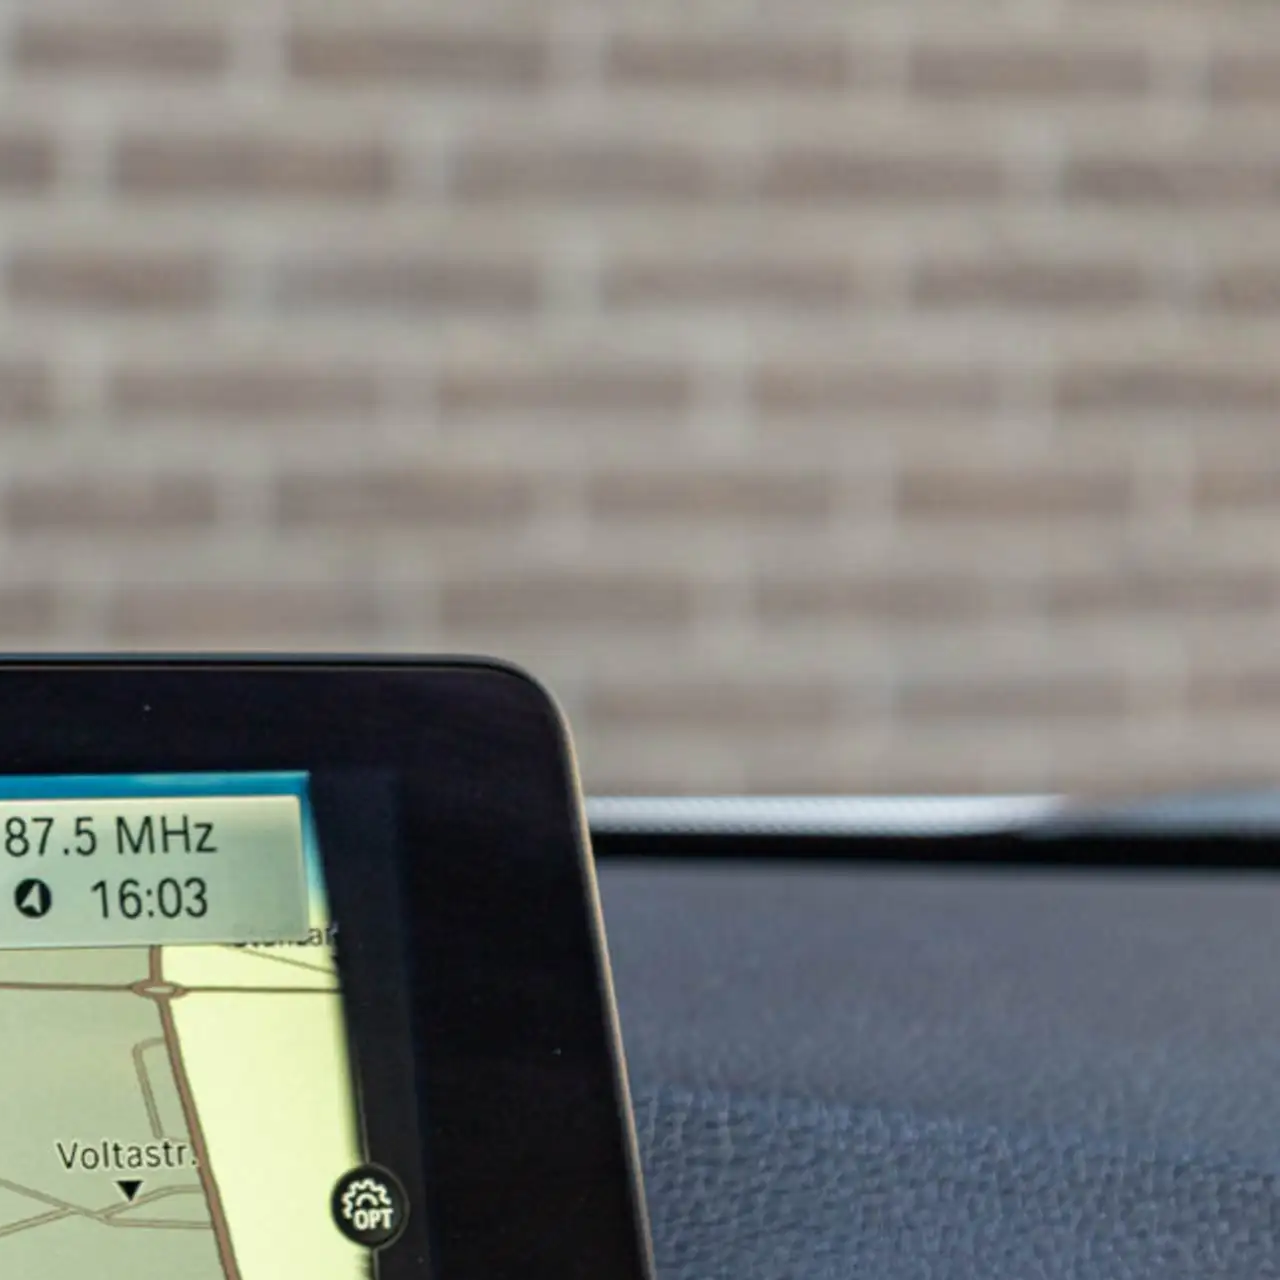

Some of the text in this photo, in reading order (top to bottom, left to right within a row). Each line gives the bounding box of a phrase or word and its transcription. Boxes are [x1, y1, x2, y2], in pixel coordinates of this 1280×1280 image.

[5, 815, 217, 858] 87.5 MHz
[92, 877, 209, 919] 16:03
[56, 1140, 199, 1172] Voltastr.
